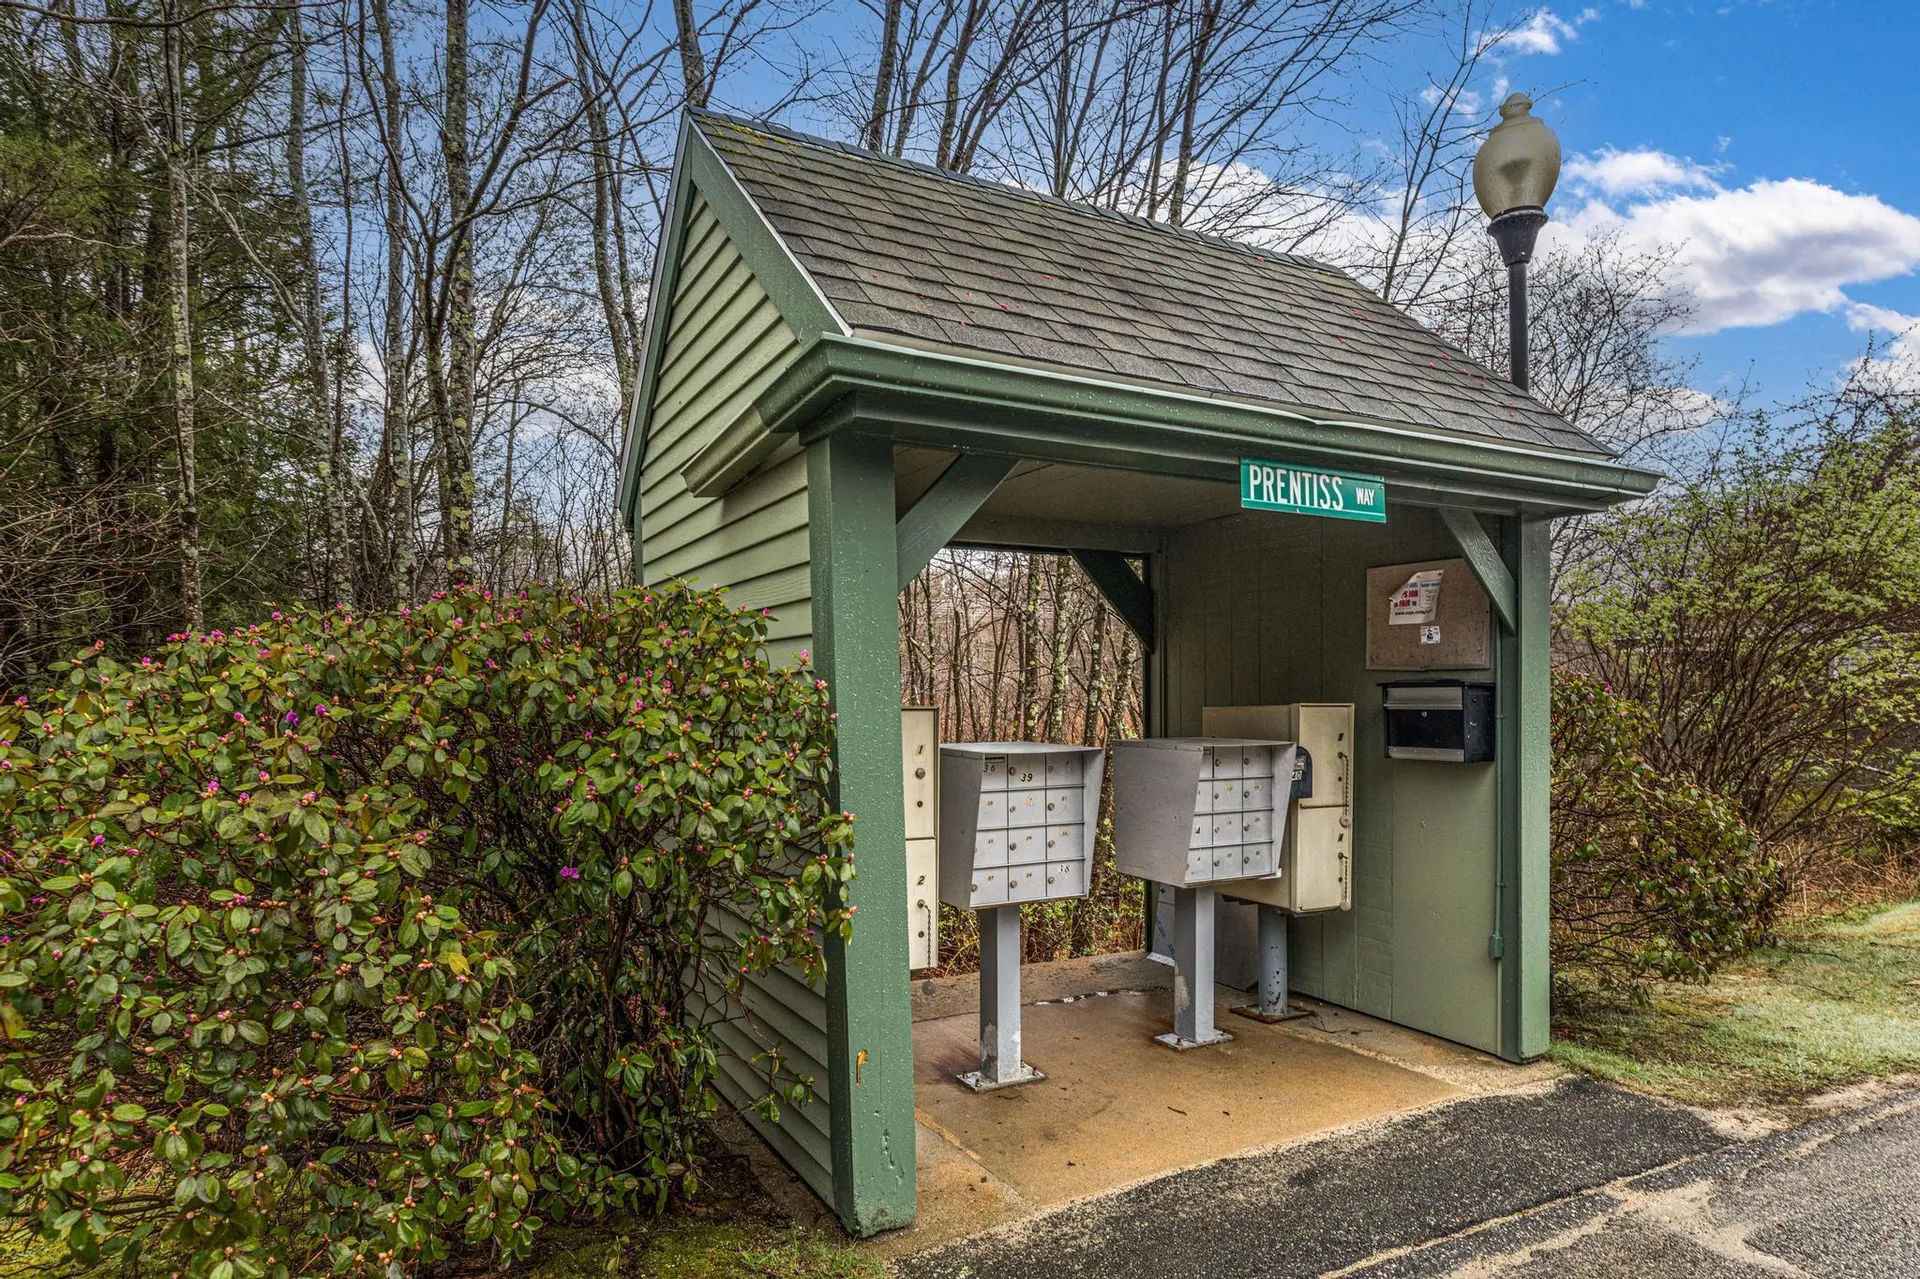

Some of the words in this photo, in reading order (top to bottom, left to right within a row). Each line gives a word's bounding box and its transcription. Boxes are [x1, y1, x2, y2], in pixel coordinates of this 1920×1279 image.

[1250, 465, 1343, 510] PRENTISS
[1356, 487, 1374, 506] WAY
[917, 745, 923, 755] 1
[1020, 773, 1033, 782] 39
[917, 875, 925, 886] 2
